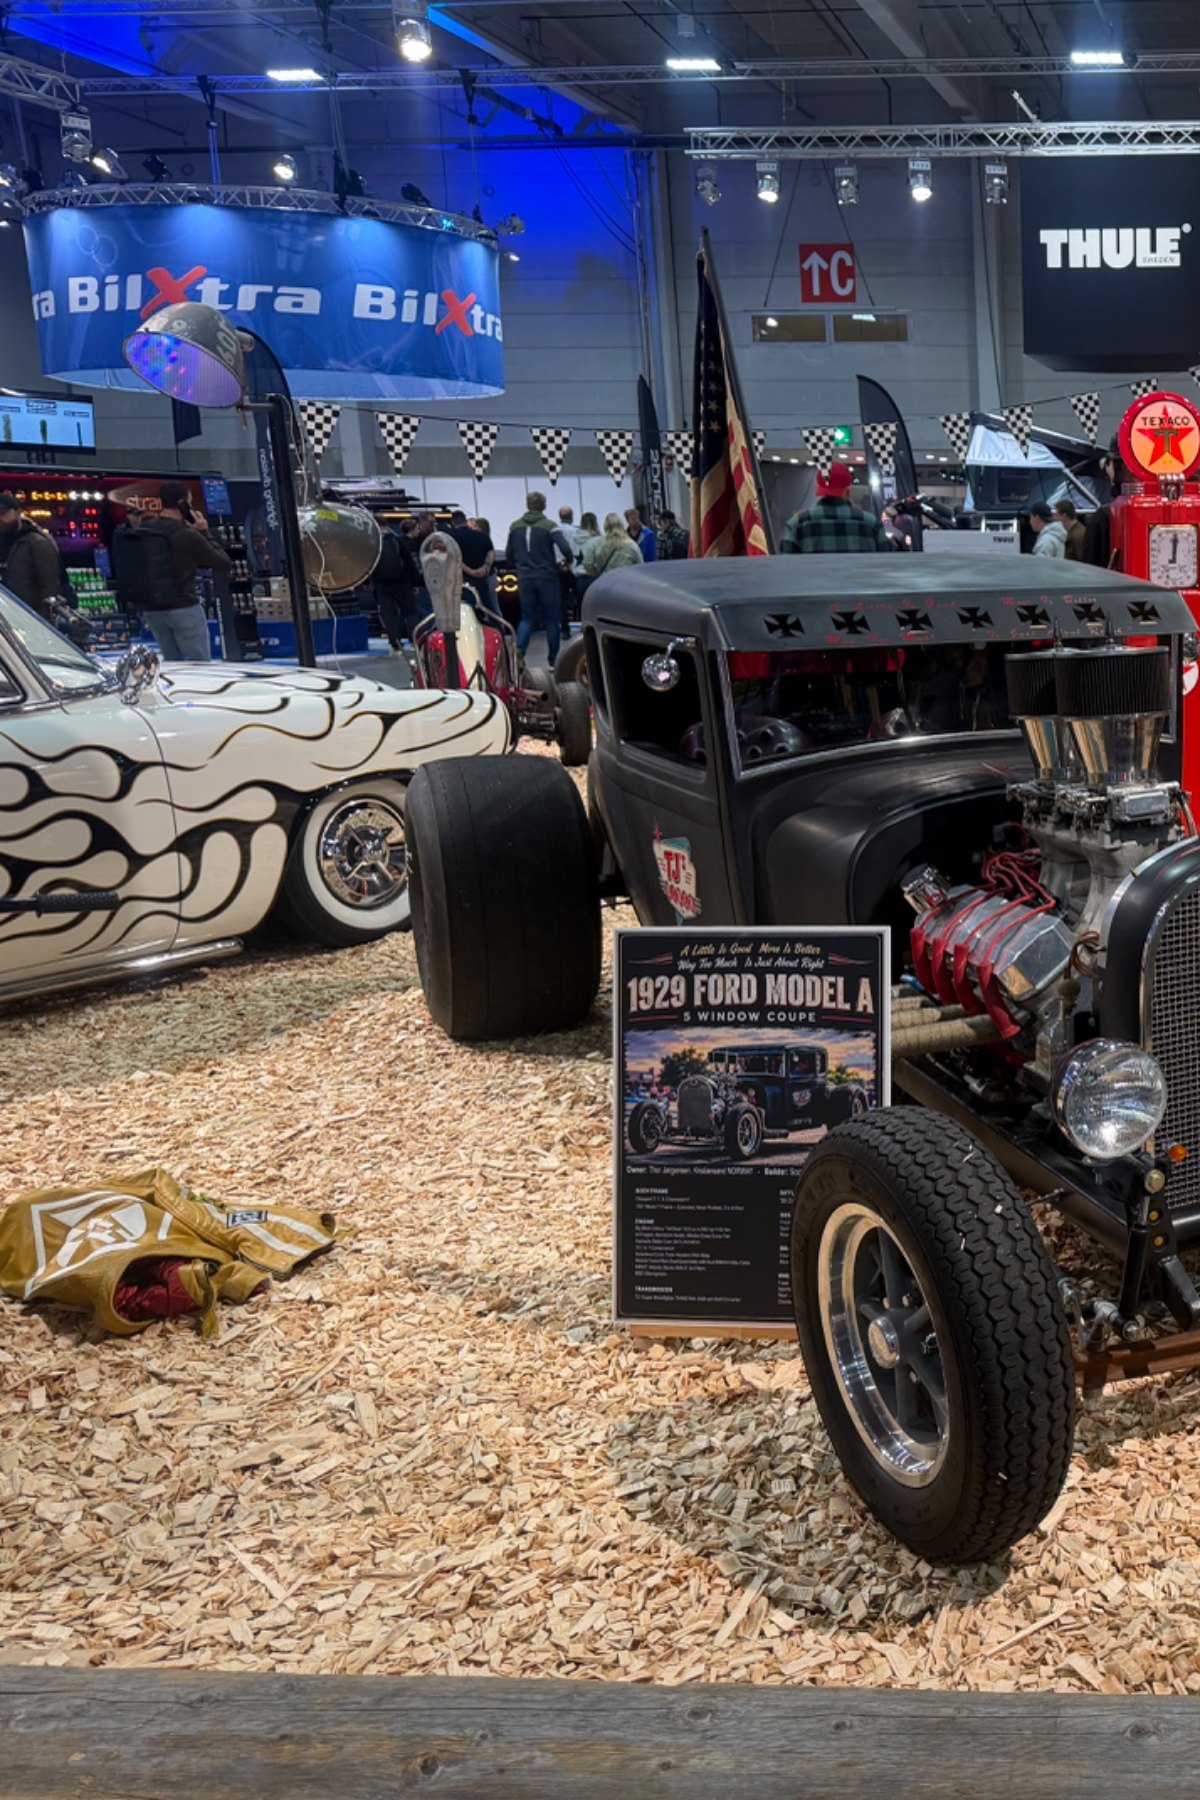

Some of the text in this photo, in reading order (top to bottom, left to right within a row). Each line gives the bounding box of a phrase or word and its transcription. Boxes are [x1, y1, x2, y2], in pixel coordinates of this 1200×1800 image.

[1040, 227, 1181, 268] THULE
[68, 265, 322, 320] BilXtra
[830, 250, 854, 296] C
[353, 284, 504, 342] BilXtra
[1141, 416, 1191, 426] TEXACO
[680, 943, 690, 957] A
[627, 973, 875, 1015] 1929 FORD MODEL A
[683, 1011, 816, 1023] 5 WINDOW COUPE
